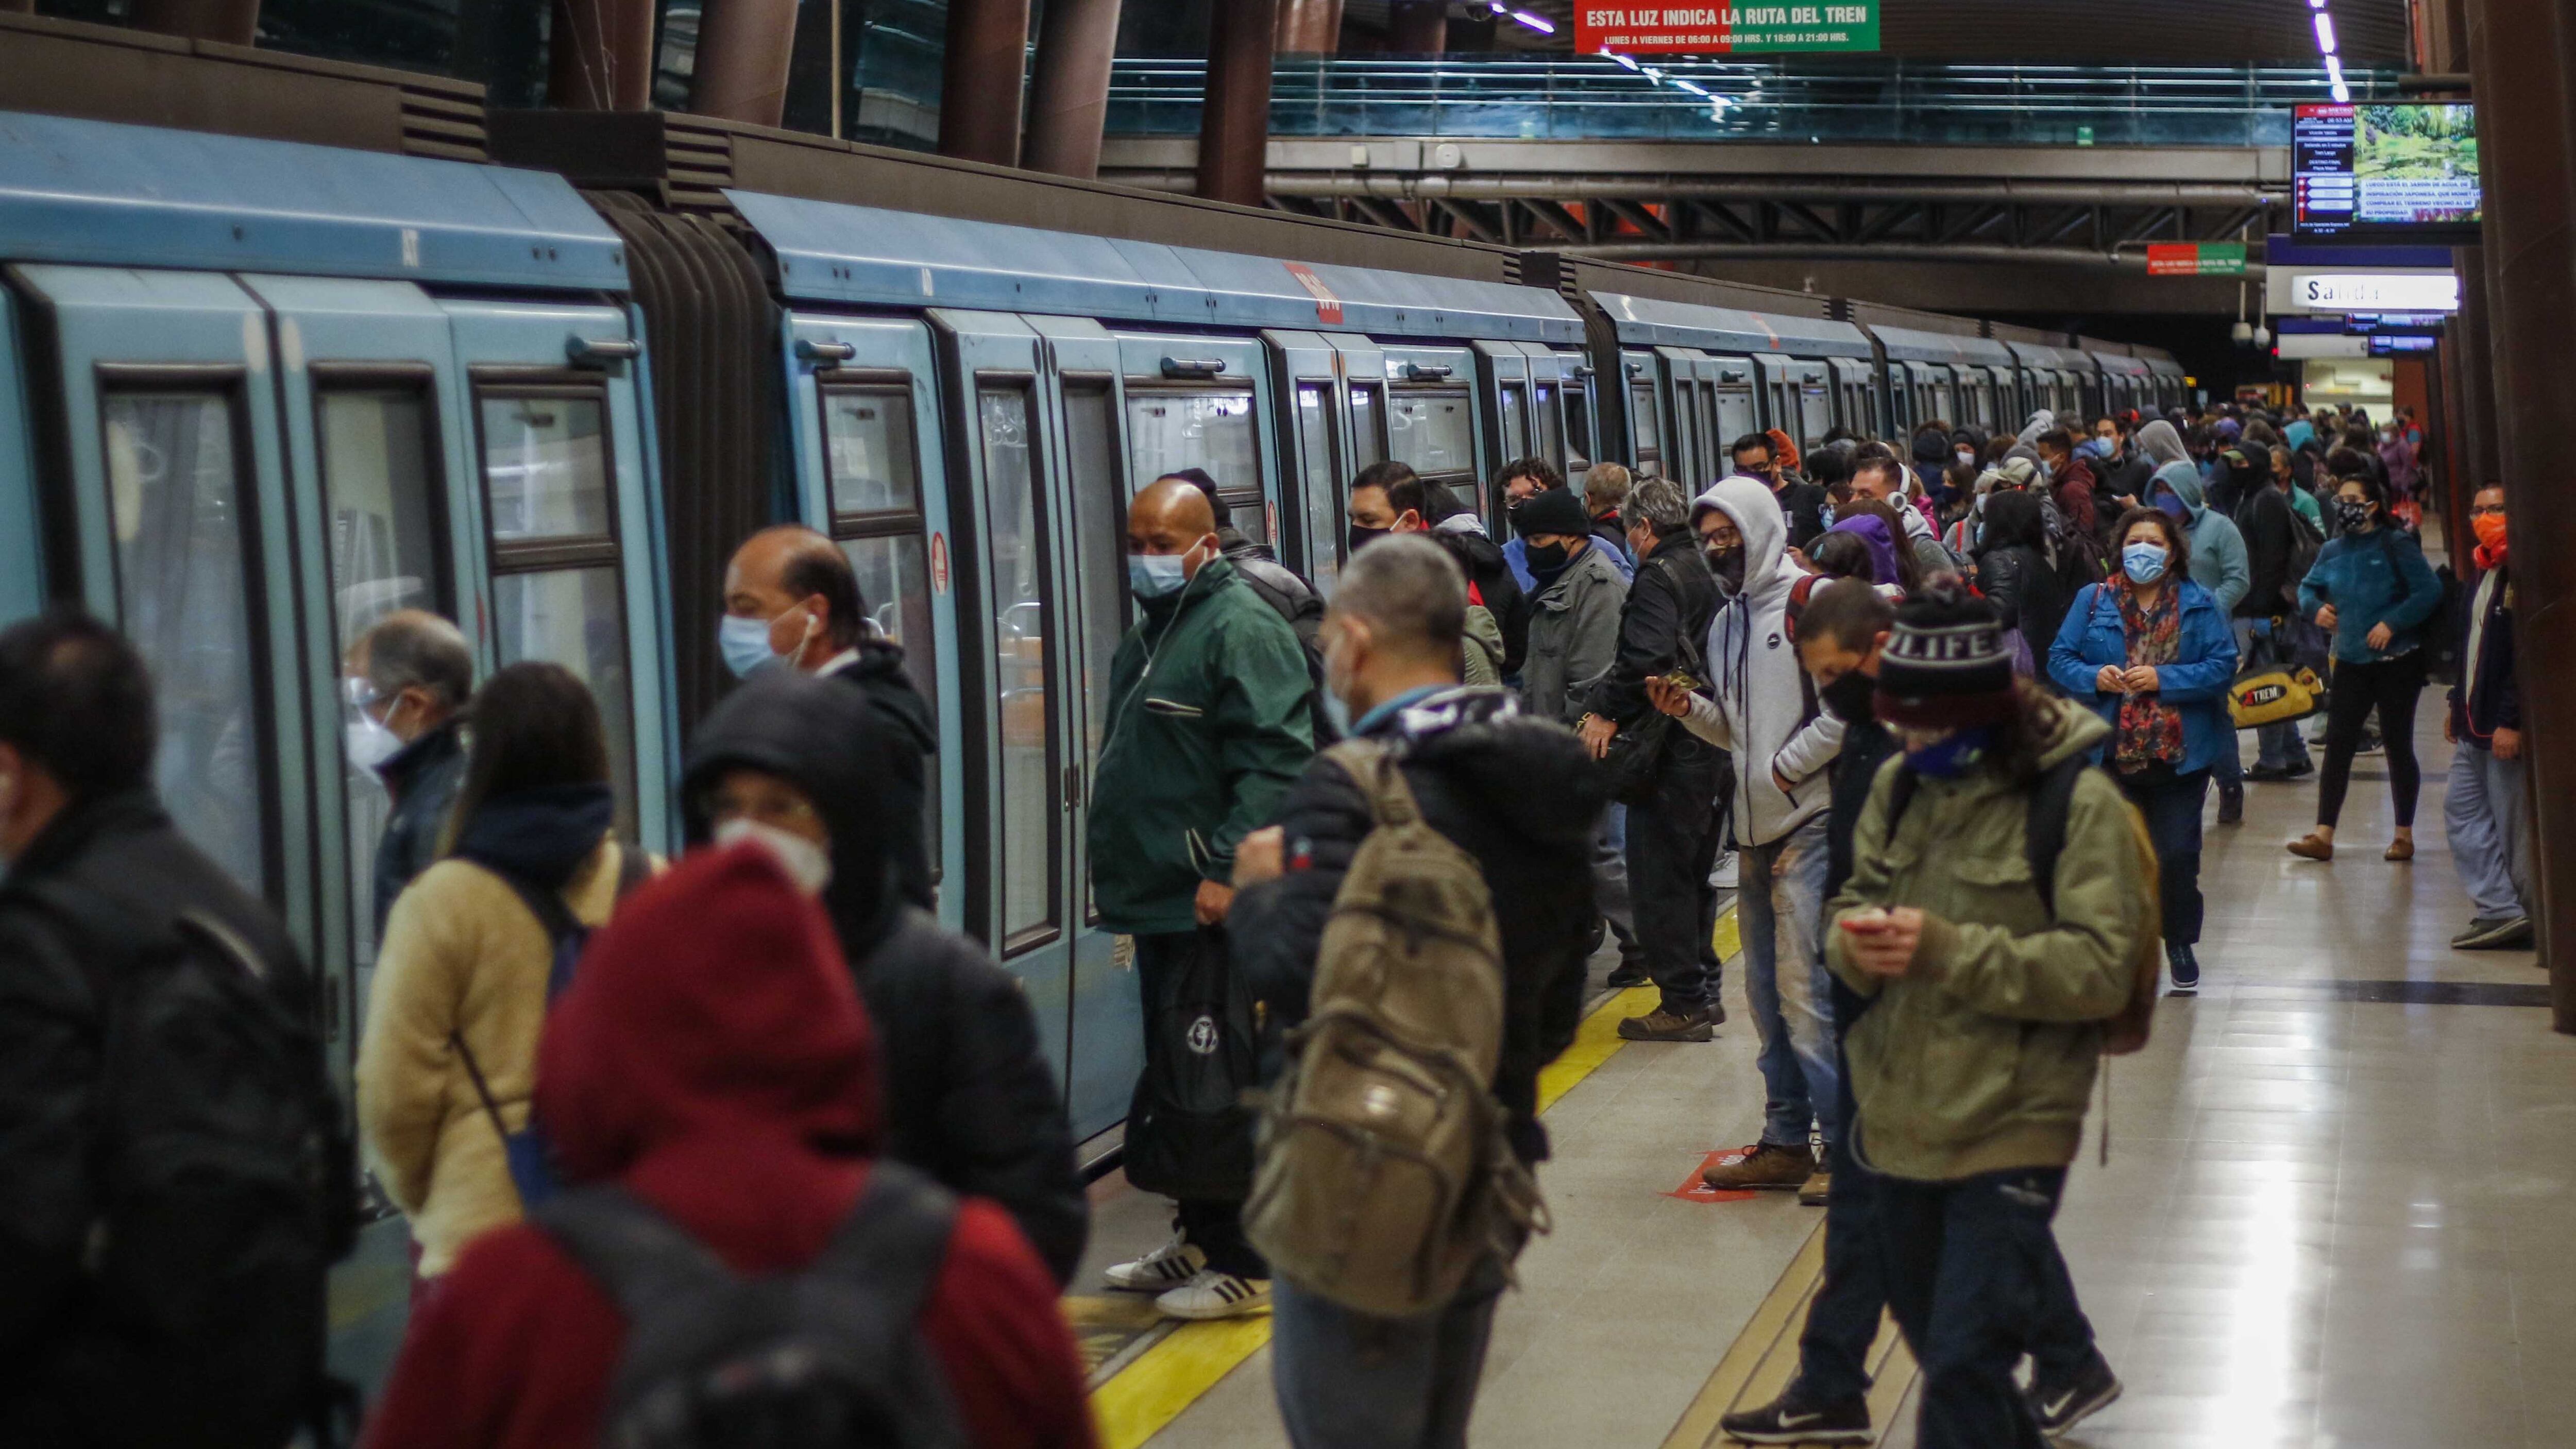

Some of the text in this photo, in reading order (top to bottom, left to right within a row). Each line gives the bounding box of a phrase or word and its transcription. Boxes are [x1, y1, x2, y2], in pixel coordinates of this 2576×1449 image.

[1587, 6, 1867, 27] ESTA LUZ INDICA LA RUTA DEL TREN
[1604, 32, 1849, 44] LUNES A VIERNES DE 06:00 A 09:00 HRS. Y 18:00 A 21:00 HRS.
